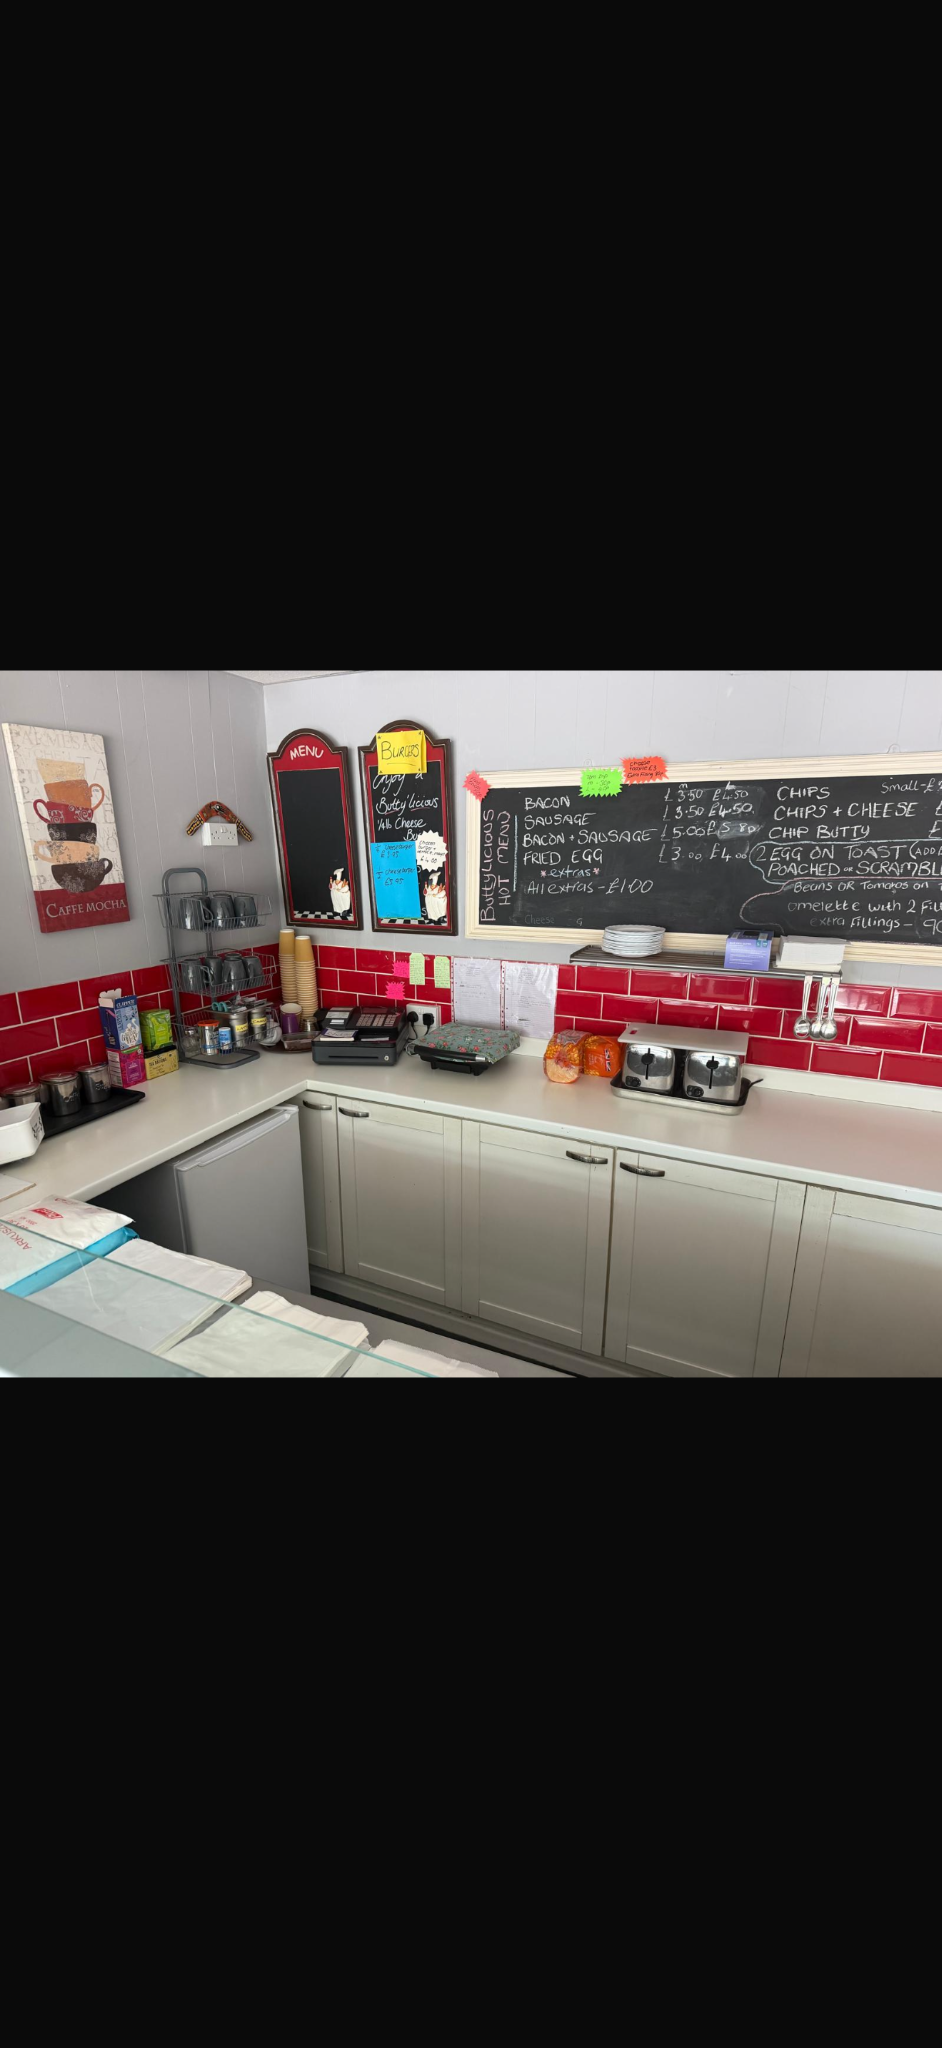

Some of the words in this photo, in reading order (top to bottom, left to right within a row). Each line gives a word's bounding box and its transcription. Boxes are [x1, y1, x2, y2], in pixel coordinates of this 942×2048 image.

[290, 744, 325, 761] MENU
[381, 740, 420, 760] BURGERS
[777, 786, 830, 801] CHIPS
[524, 795, 571, 811] BACON
[774, 804, 828, 821] CHIPS
[847, 802, 919, 818] CHEESE
[395, 817, 427, 830] Cheese
[524, 812, 597, 830] SAUSAGE
[496, 810, 511, 864] MENU
[522, 832, 565, 848] BACON
[578, 828, 658, 845] SAUSAGE
[769, 826, 809, 839] CHIP
[523, 850, 562, 866] FRIED
[571, 848, 603, 864] EGG
[770, 847, 803, 861] EGG
[810, 845, 834, 860] ON
[843, 844, 907, 860] TOAST
[767, 862, 840, 878] POACHED
[855, 860, 942, 877] SCRAMBL
[498, 875, 511, 906] HOT
[547, 880, 594, 895] extras
[793, 881, 833, 893] Beans
[837, 880, 855, 891] OR
[46, 903, 84, 918] CAFFE
[86, 899, 127, 913] MOCHA
[868, 900, 901, 913] with
[905, 899, 916, 914] 2
[809, 916, 845, 927] extra
